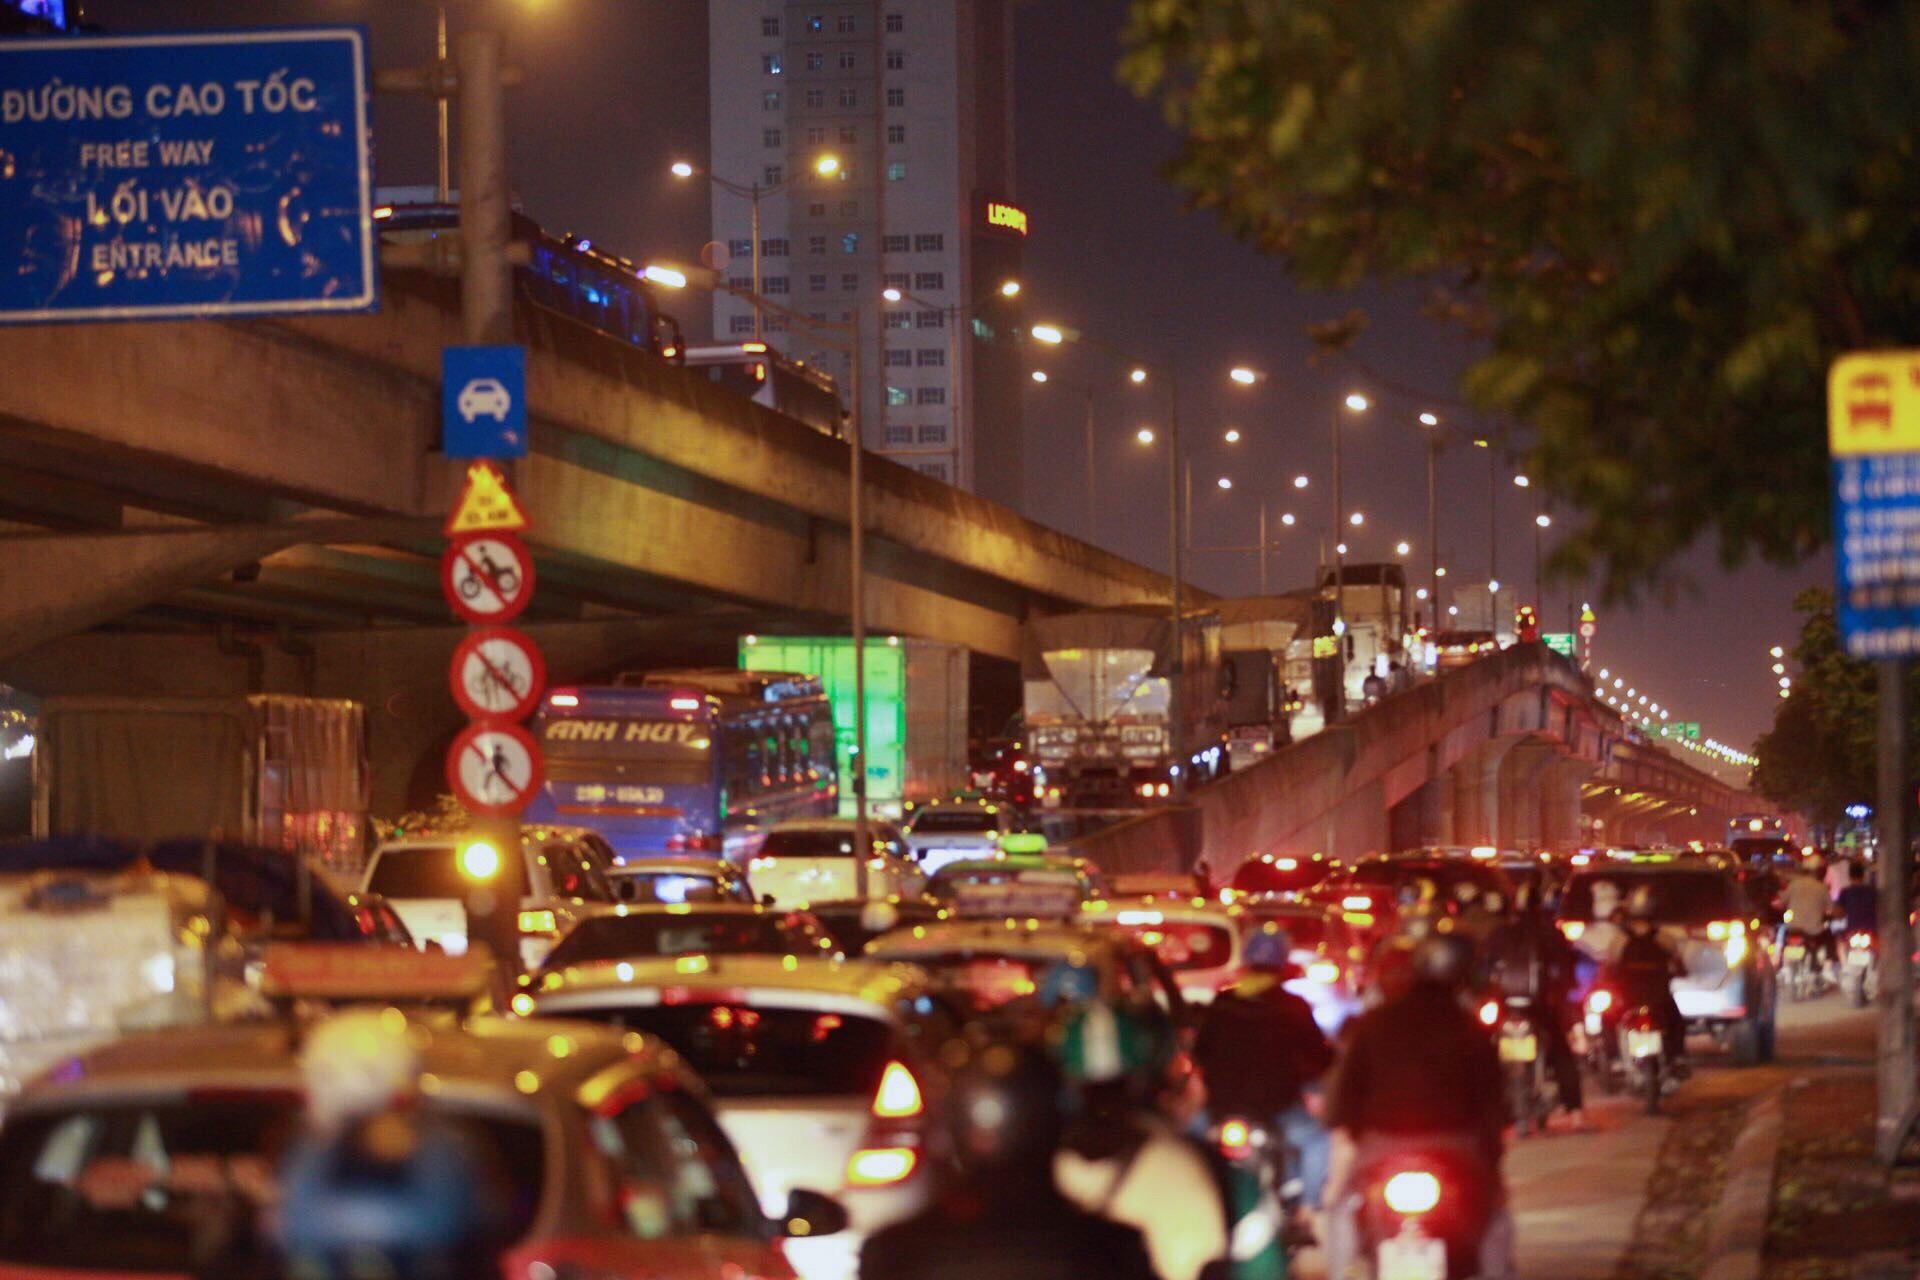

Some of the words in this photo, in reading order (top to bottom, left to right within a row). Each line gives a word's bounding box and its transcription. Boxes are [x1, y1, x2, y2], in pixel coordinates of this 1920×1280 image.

[2, 76, 133, 122] ĐƯỜNG
[146, 82, 225, 118] CAO
[235, 67, 317, 114] TỐC
[80, 139, 149, 168] FREE
[159, 139, 214, 166] WAY
[87, 178, 149, 224] LỐI
[161, 177, 234, 221] VÀO
[92, 239, 239, 271] ENTRANCE
[545, 720, 619, 741] ANH
[623, 721, 696, 743] HUY
